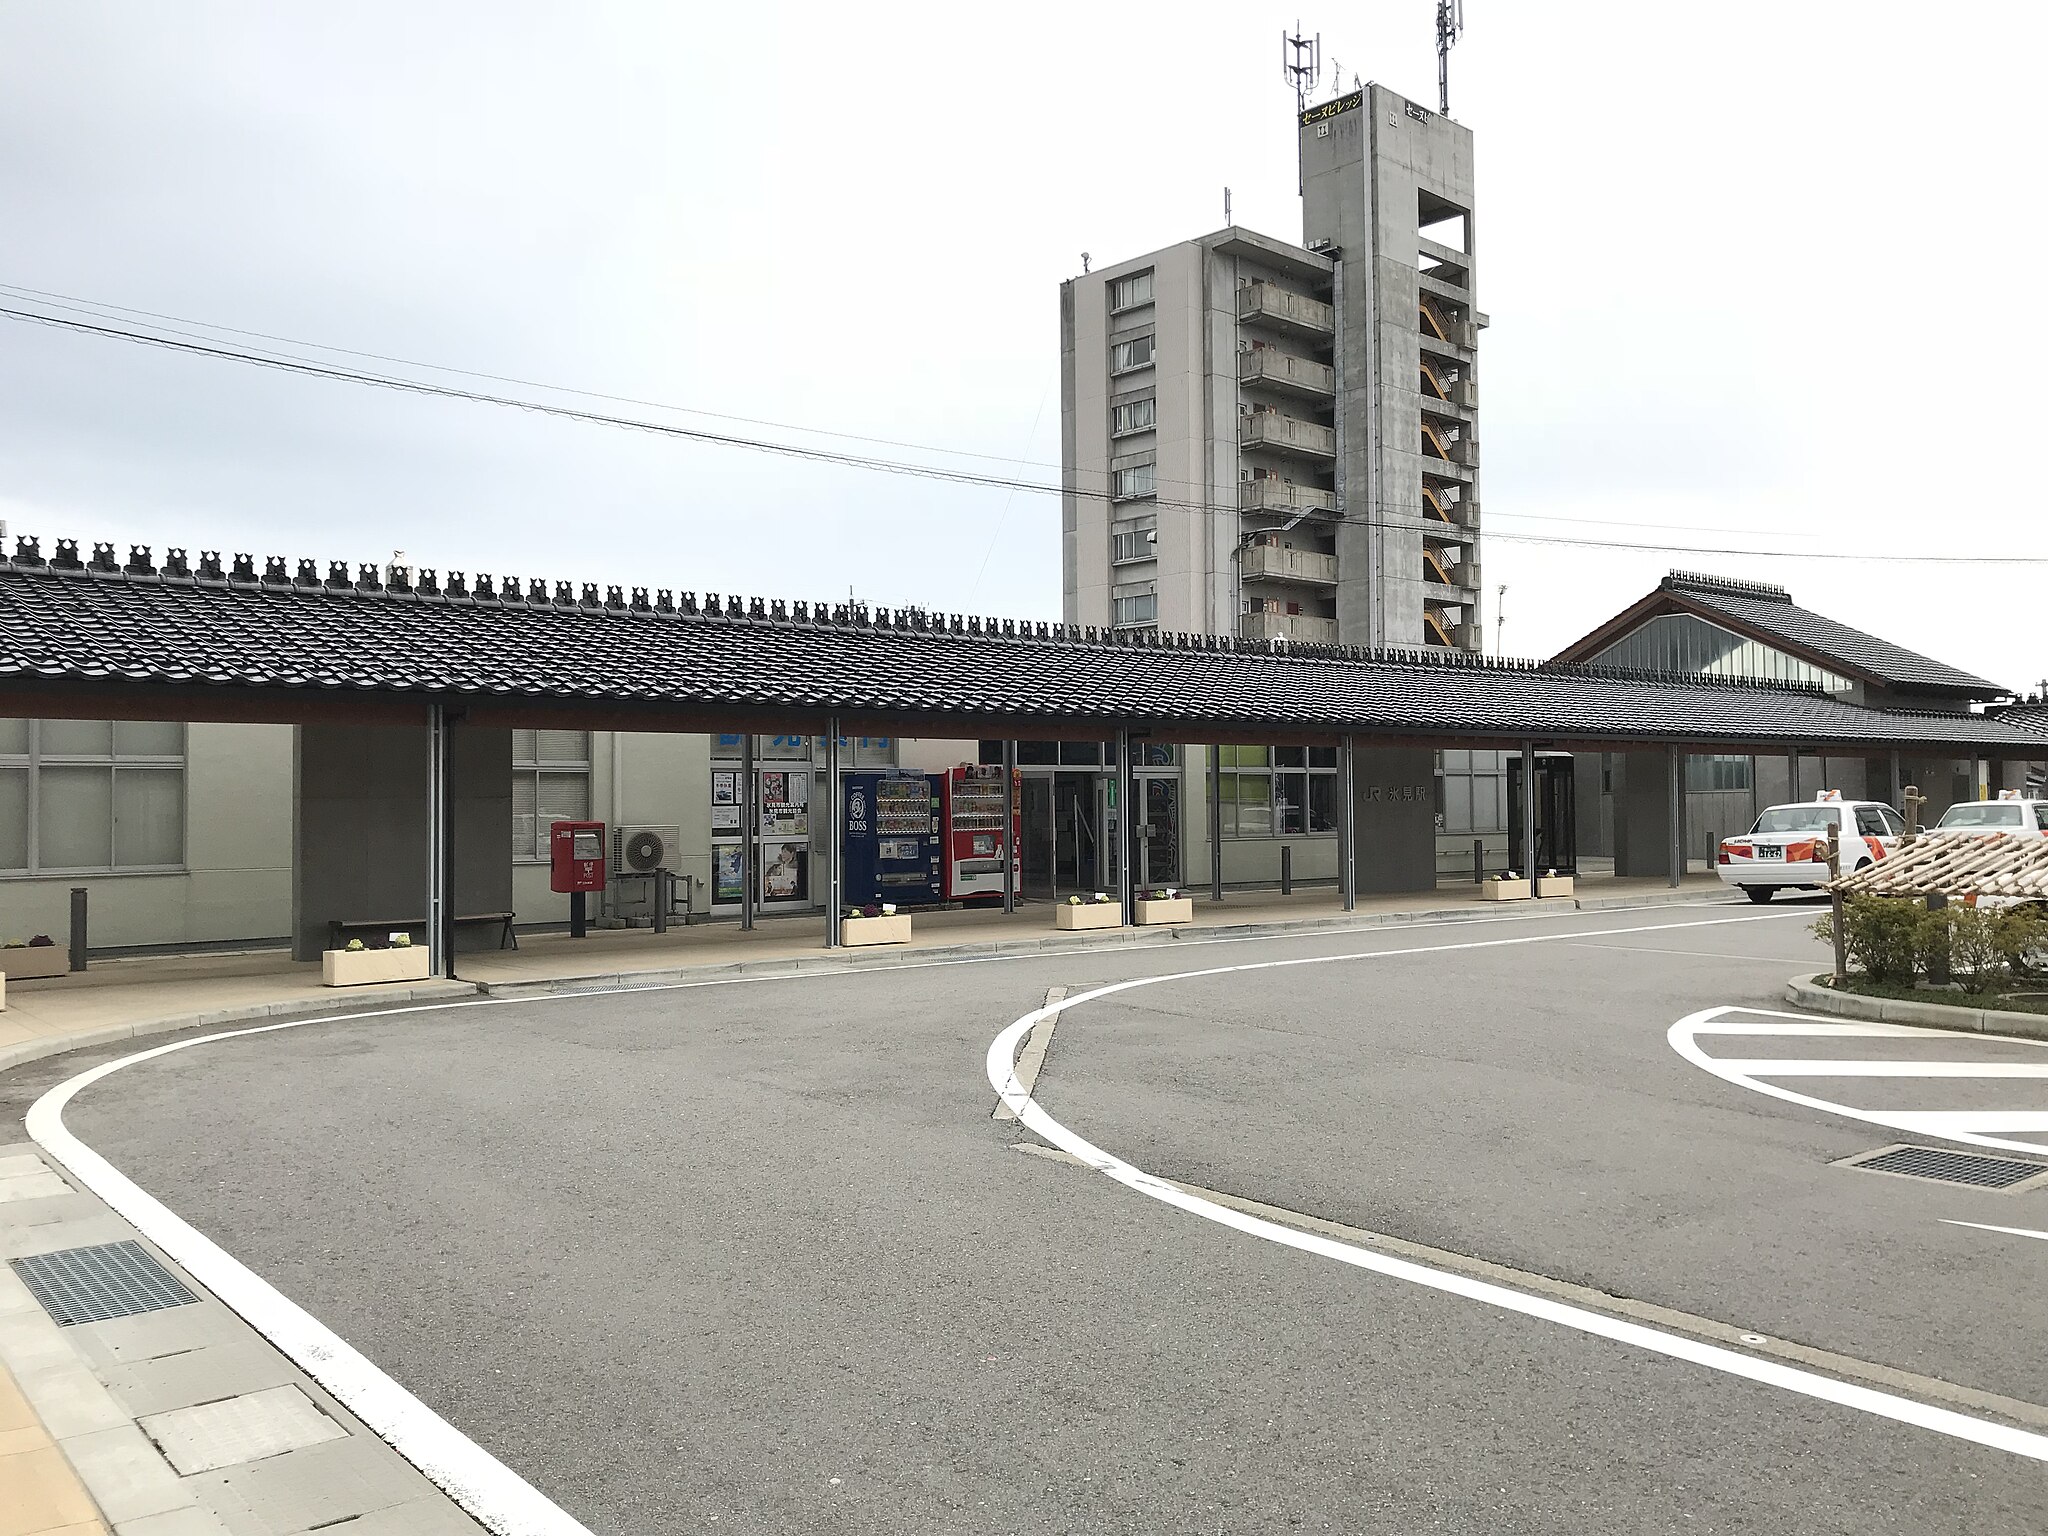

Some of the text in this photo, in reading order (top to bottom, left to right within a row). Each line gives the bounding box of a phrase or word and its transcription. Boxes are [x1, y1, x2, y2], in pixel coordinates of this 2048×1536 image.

[1362, 786, 1426, 801] JR 氷見駅
[849, 820, 867, 831] BOSS
